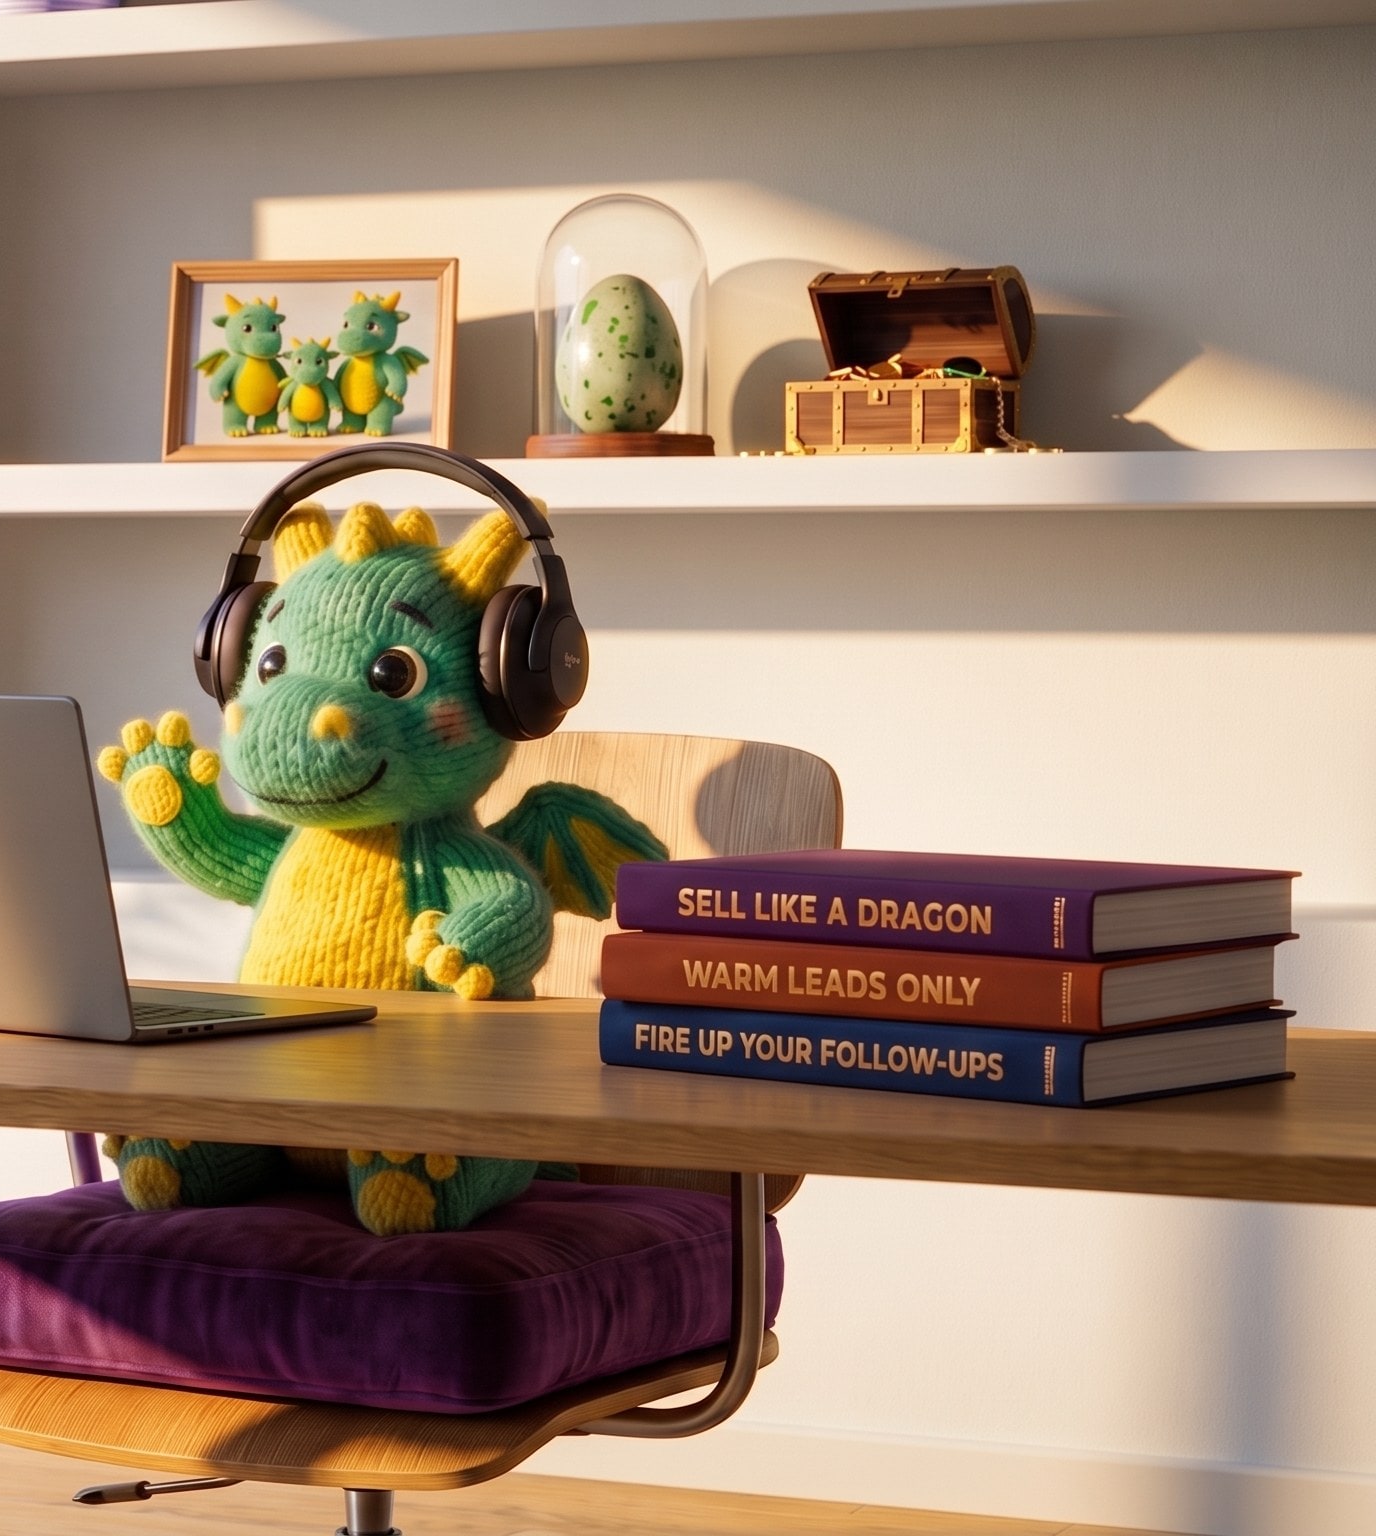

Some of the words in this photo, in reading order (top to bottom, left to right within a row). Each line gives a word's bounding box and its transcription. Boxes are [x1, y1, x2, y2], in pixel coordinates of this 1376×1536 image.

[677, 887, 746, 920] SELL
[754, 892, 817, 924] LIKE
[826, 896, 849, 926] A
[858, 898, 992, 935] DRAGON
[682, 959, 779, 993] WARM
[788, 965, 887, 1001] LEADS
[896, 972, 981, 1006] ONLY
[634, 1023, 691, 1054] FIRE
[698, 1028, 734, 1057] UP
[739, 1031, 813, 1065] YOUR
[820, 1038, 1004, 1082] FOLLOW-UPS
